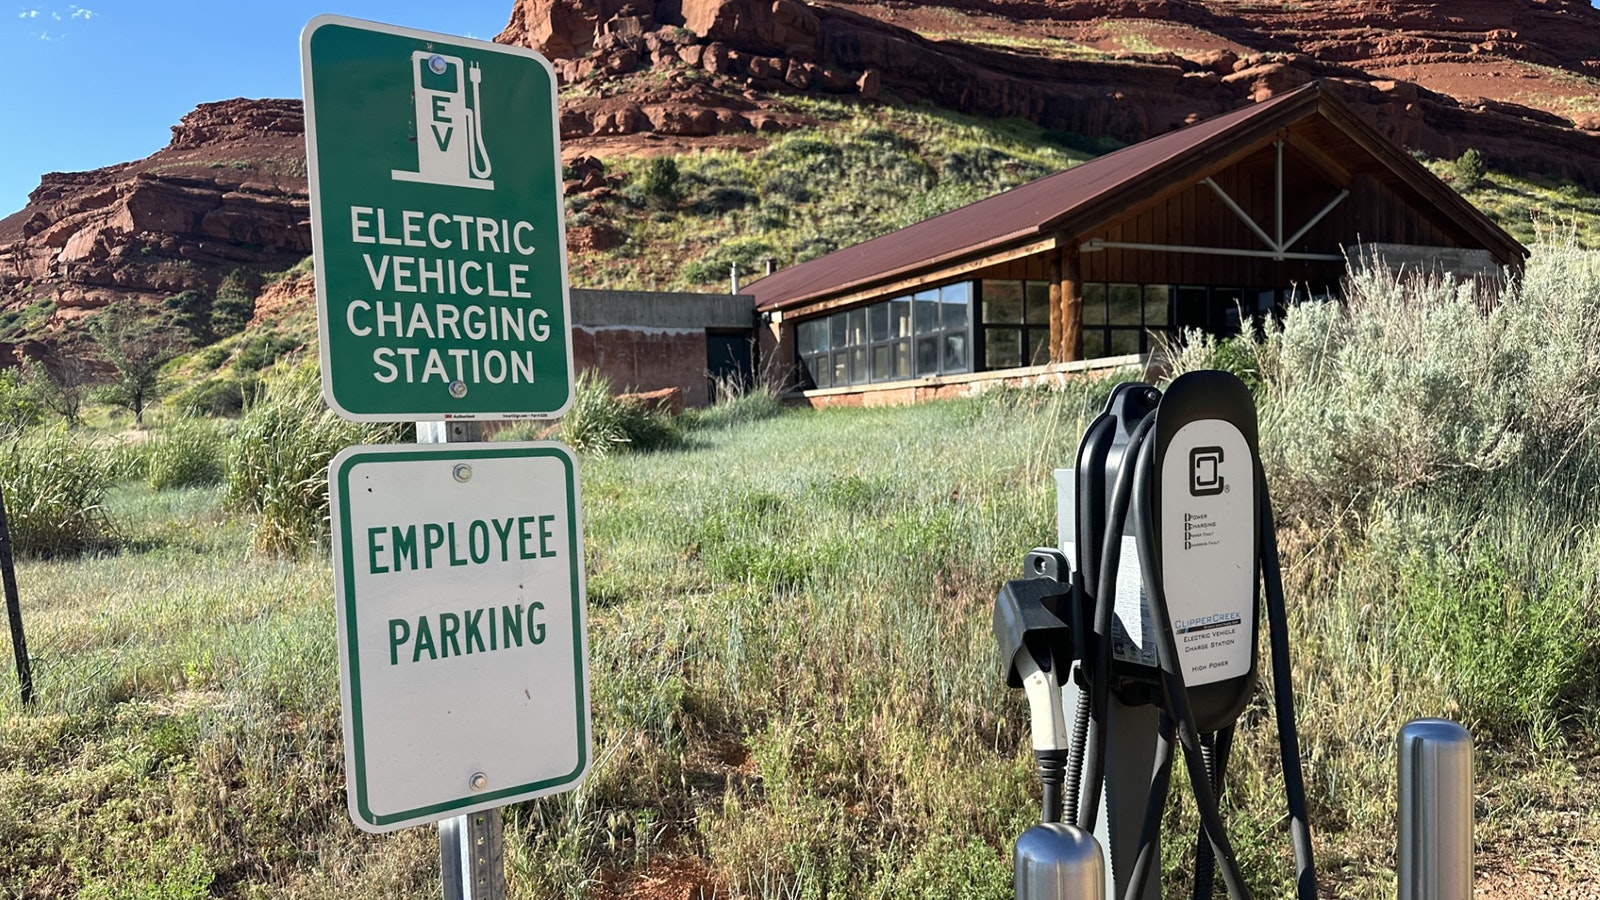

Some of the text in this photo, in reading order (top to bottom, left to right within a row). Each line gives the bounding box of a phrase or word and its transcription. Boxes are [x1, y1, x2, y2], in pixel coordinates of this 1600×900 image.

[350, 205, 535, 255] ELECTRIC
[363, 253, 531, 298] VEHICLE
[346, 300, 550, 342] CHARGING
[372, 347, 534, 384] STATION
[367, 514, 557, 574] EMPLOYEE
[388, 601, 546, 666] PARKING
[1183, 628, 1236, 643] ELECTRIC VEHICLE
[1185, 639, 1235, 653] CHARGE STATION
[1191, 660, 1229, 673] HIGH POWER
